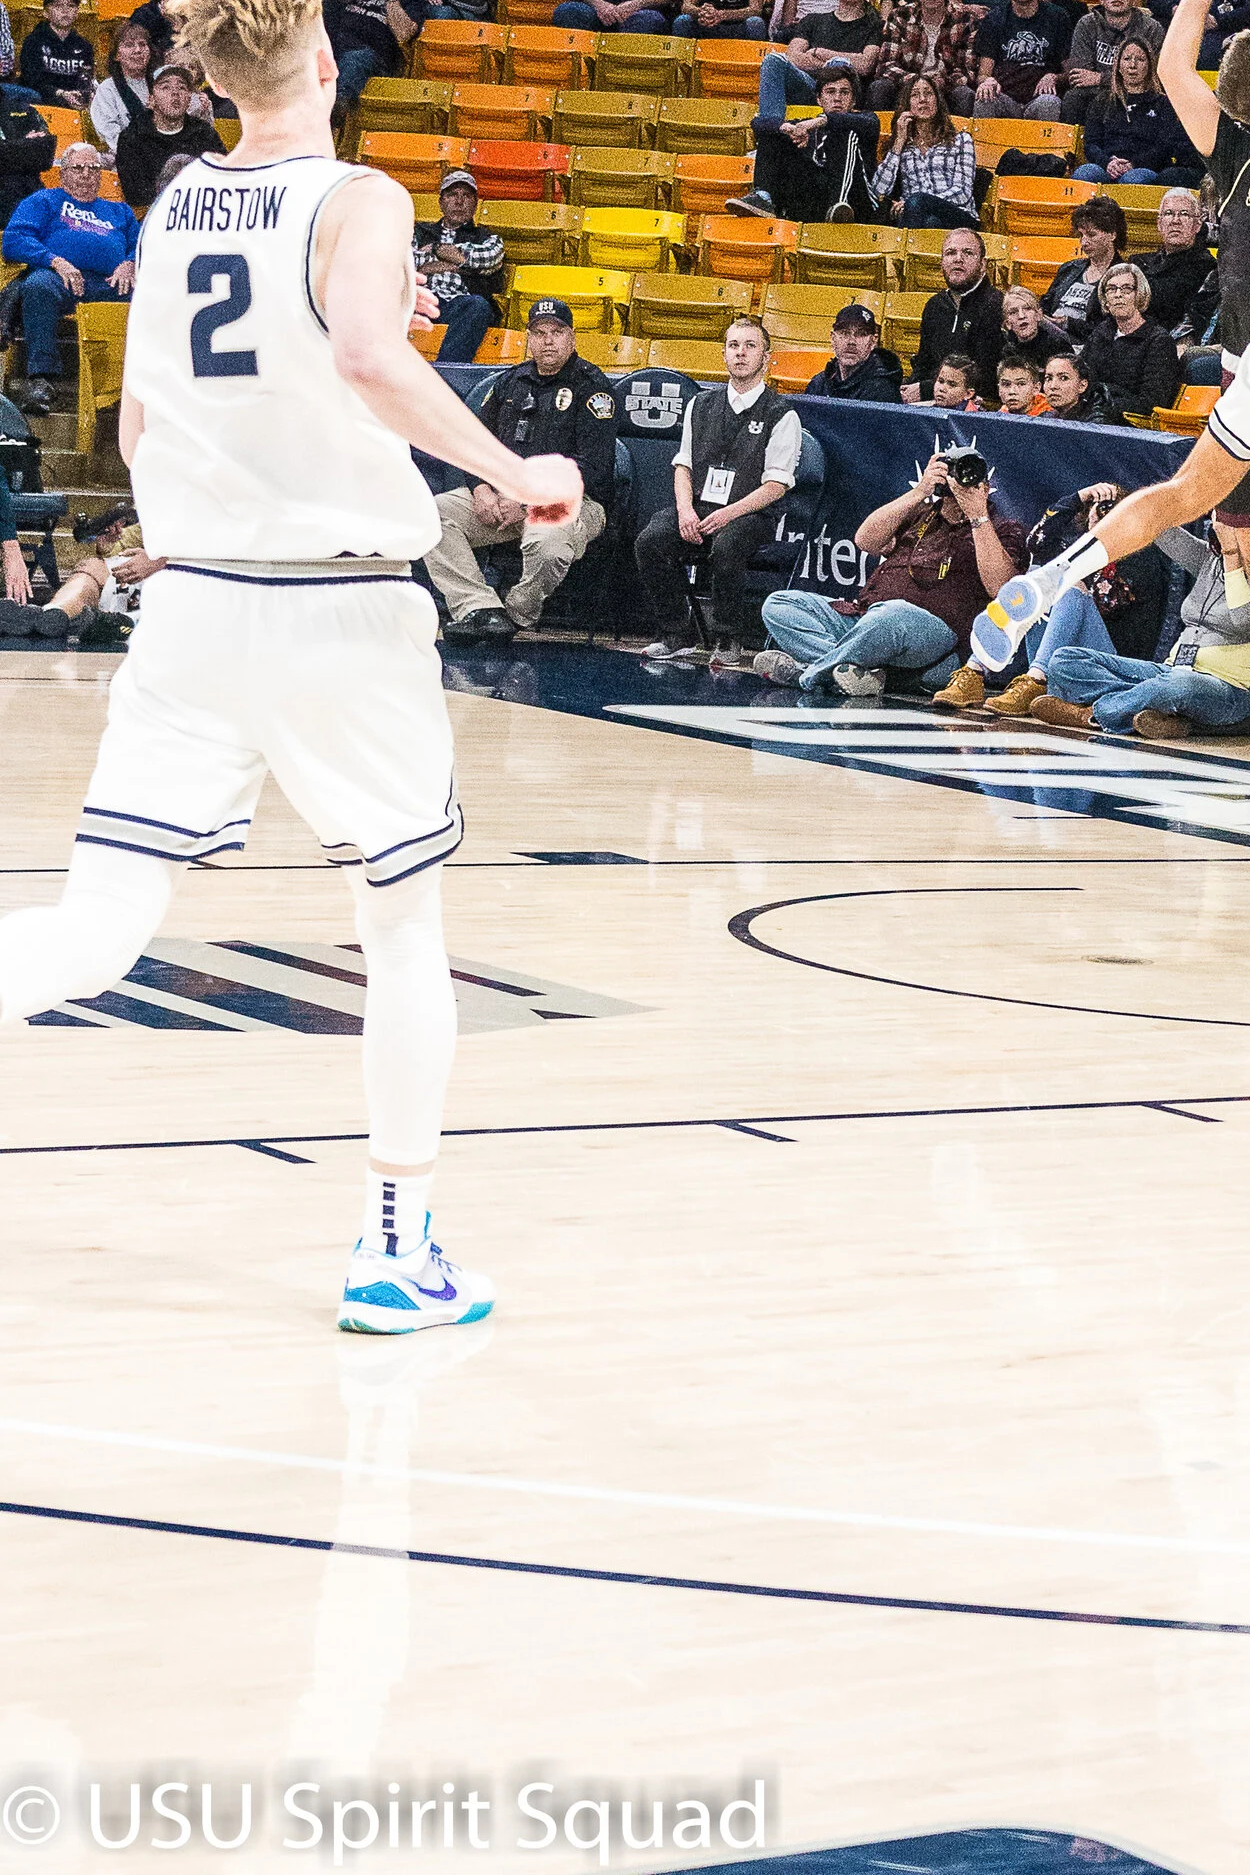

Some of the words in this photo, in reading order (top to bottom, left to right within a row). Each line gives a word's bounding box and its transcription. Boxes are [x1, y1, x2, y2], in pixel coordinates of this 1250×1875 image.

[166, 185, 288, 232] BAIRSTOW
[187, 253, 260, 378] 2
[625, 394, 683, 415] STATE
